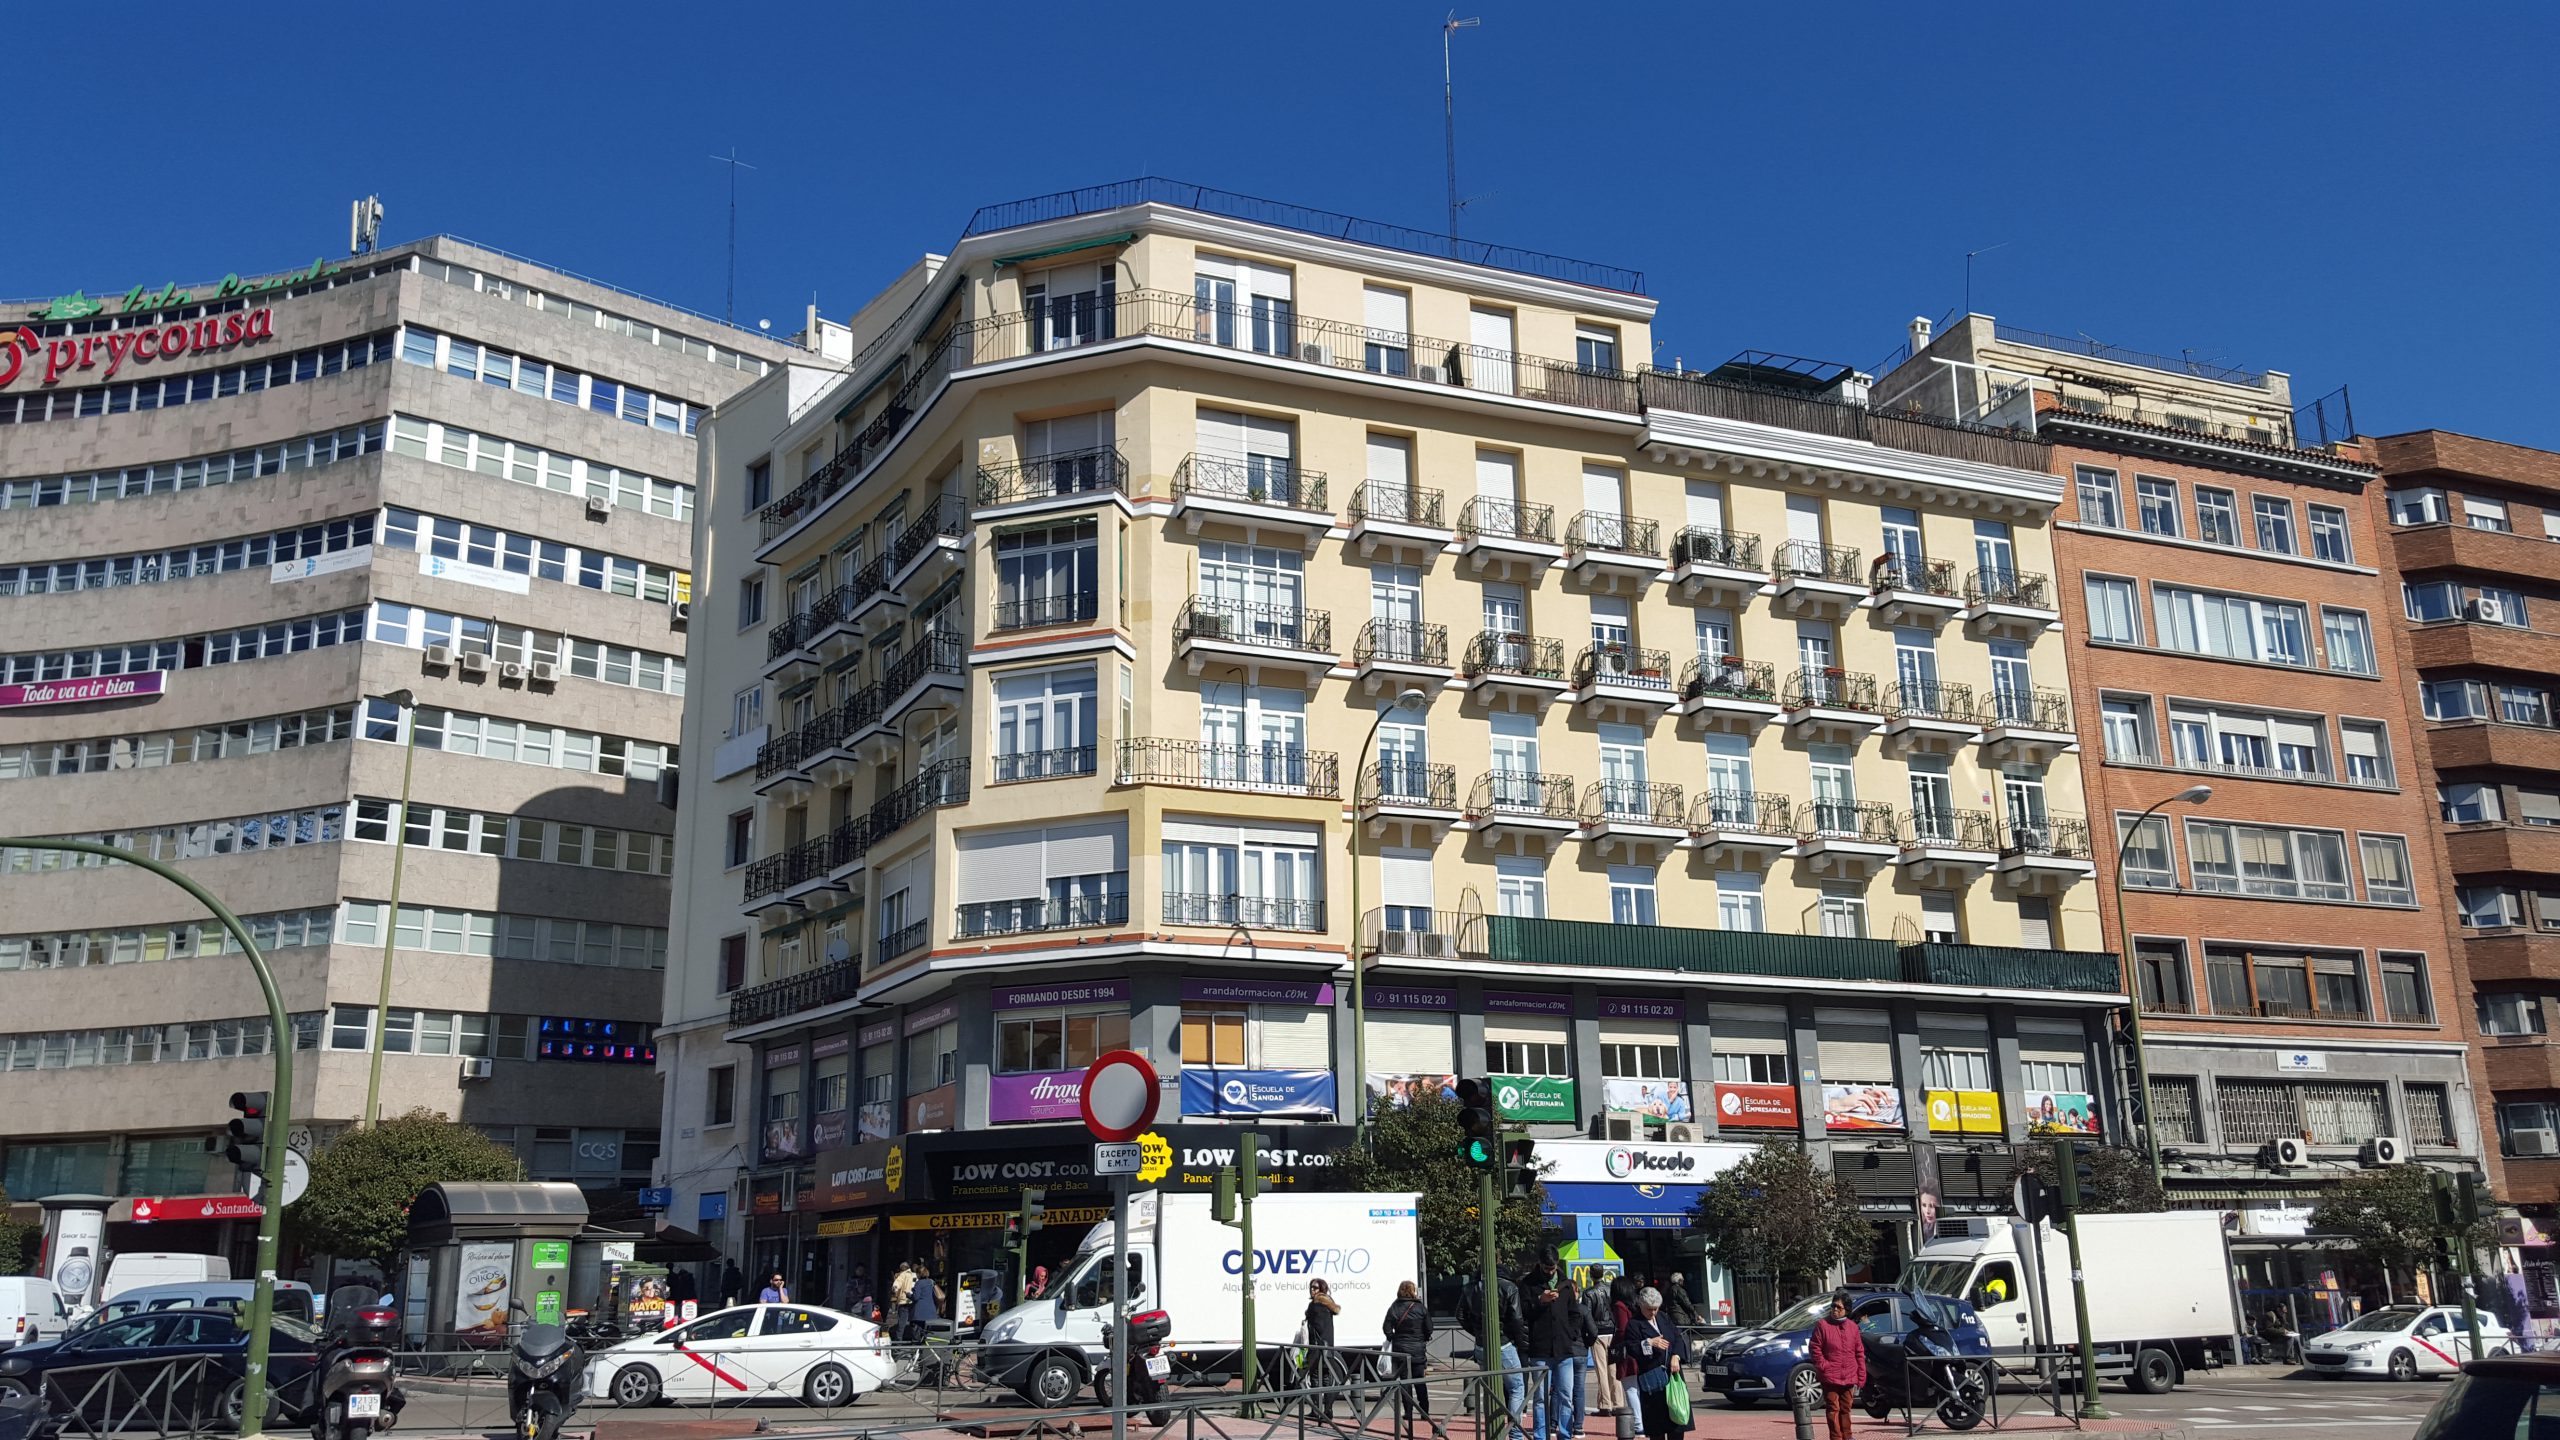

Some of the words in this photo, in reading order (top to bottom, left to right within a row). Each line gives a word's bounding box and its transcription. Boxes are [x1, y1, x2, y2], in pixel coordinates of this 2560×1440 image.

[43, 308, 274, 383] pryconsa
[22, 685, 56, 702] Todo
[58, 685, 75, 699] va
[78, 685, 87, 697] a
[90, 680, 104, 696] ir
[105, 678, 135, 695] bien
[1009, 991, 1059, 1005] FORMANDO
[1061, 988, 1090, 1001] DESDE
[1093, 987, 1115, 998] 1994
[1202, 986, 1309, 999] arandaformacion.com
[1389, 993, 1400, 1004] 91
[1403, 993, 1420, 1004] 115
[1422, 994, 1434, 1005] 02
[1435, 994, 1447, 1005] 20
[1488, 997, 1566, 1010] arandaformacion.com
[1621, 1004, 1631, 1014] 91
[1633, 1004, 1650, 1014] 115
[1651, 1005, 1662, 1015] 02
[1663, 1005, 1674, 1016] 20
[542, 1019, 617, 1035] AUTO
[288, 1131, 308, 1149] QS
[1100, 1149, 1138, 1158] EXCEPTO
[1142, 1144, 1164, 1153] OW
[888, 1156, 900, 1166] LOW
[1107, 1159, 1130, 1168] E.M.T.
[1141, 1156, 1166, 1165] OST
[1182, 1148, 1236, 1166] LOW
[1632, 1150, 1695, 1171] Piccolo
[832, 1170, 848, 1187] LOW
[887, 1167, 900, 1177] COST
[952, 1164, 998, 1181] LOW
[952, 1184, 1009, 1195] Francesiñas
[1050, 1182, 1063, 1191] de
[1622, 1217, 1645, 1226] 101%
[469, 1270, 501, 1285] OIKOS
[1259, 1281, 1272, 1291] de
[629, 1301, 665, 1312] MAYOR
